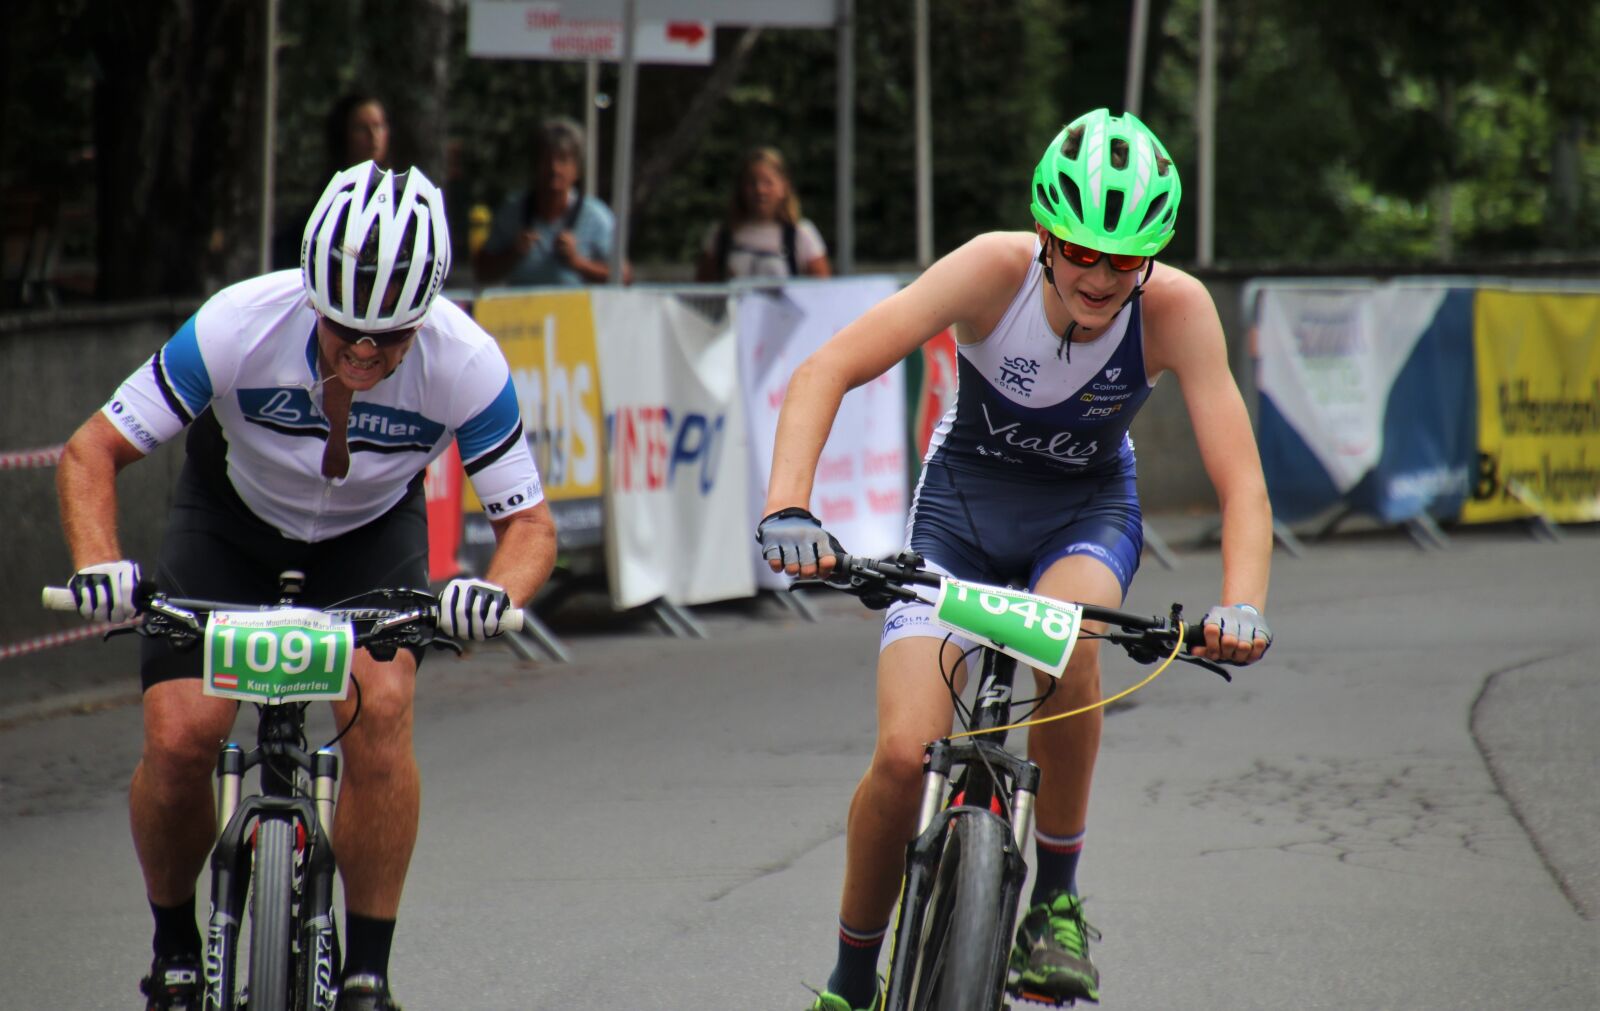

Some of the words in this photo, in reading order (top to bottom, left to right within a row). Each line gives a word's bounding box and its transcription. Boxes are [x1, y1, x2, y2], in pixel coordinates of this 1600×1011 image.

[994, 377, 1031, 399] COLMAR
[1000, 366, 1035, 392] TAC
[1092, 383, 1128, 391] Colmar
[982, 402, 1098, 457] Vialis
[231, 618, 264, 627] Montafon
[266, 617, 312, 627] Mountainbike
[896, 614, 931, 625] COLMA
[217, 627, 337, 675] 1091
[247, 679, 270, 693] Kurt
[273, 682, 329, 694] Vonderleu
